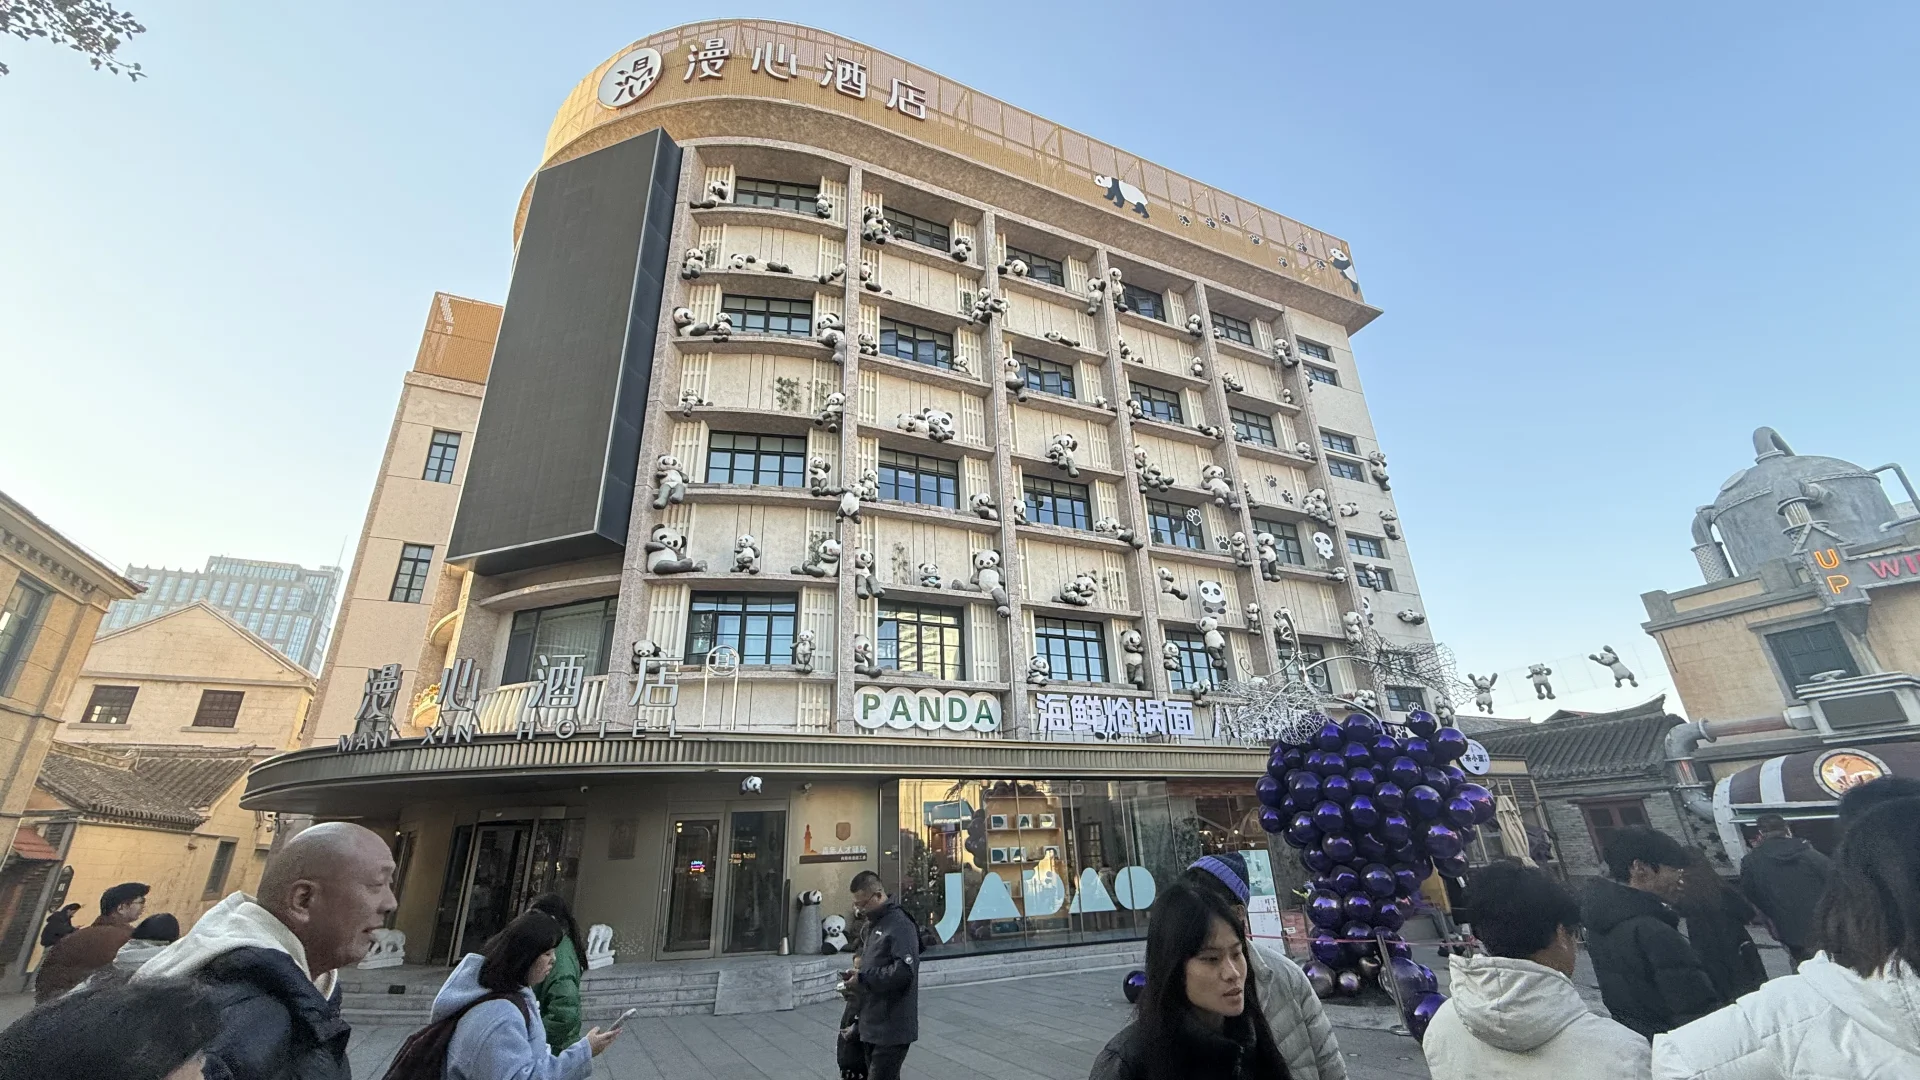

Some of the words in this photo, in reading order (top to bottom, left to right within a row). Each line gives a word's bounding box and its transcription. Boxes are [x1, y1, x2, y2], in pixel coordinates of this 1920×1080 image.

[683, 38, 926, 121] 漫心酒店
[1814, 549, 1850, 594] UP
[1867, 553, 1920, 579] WI
[354, 654, 683, 721] 漫心酒店
[862, 693, 996, 725] PANDA
[336, 730, 389, 753] MAN
[421, 724, 475, 745] XIN
[516, 719, 683, 741] HOTEL
[1036, 692, 1195, 736] 海鲜炝锅面
